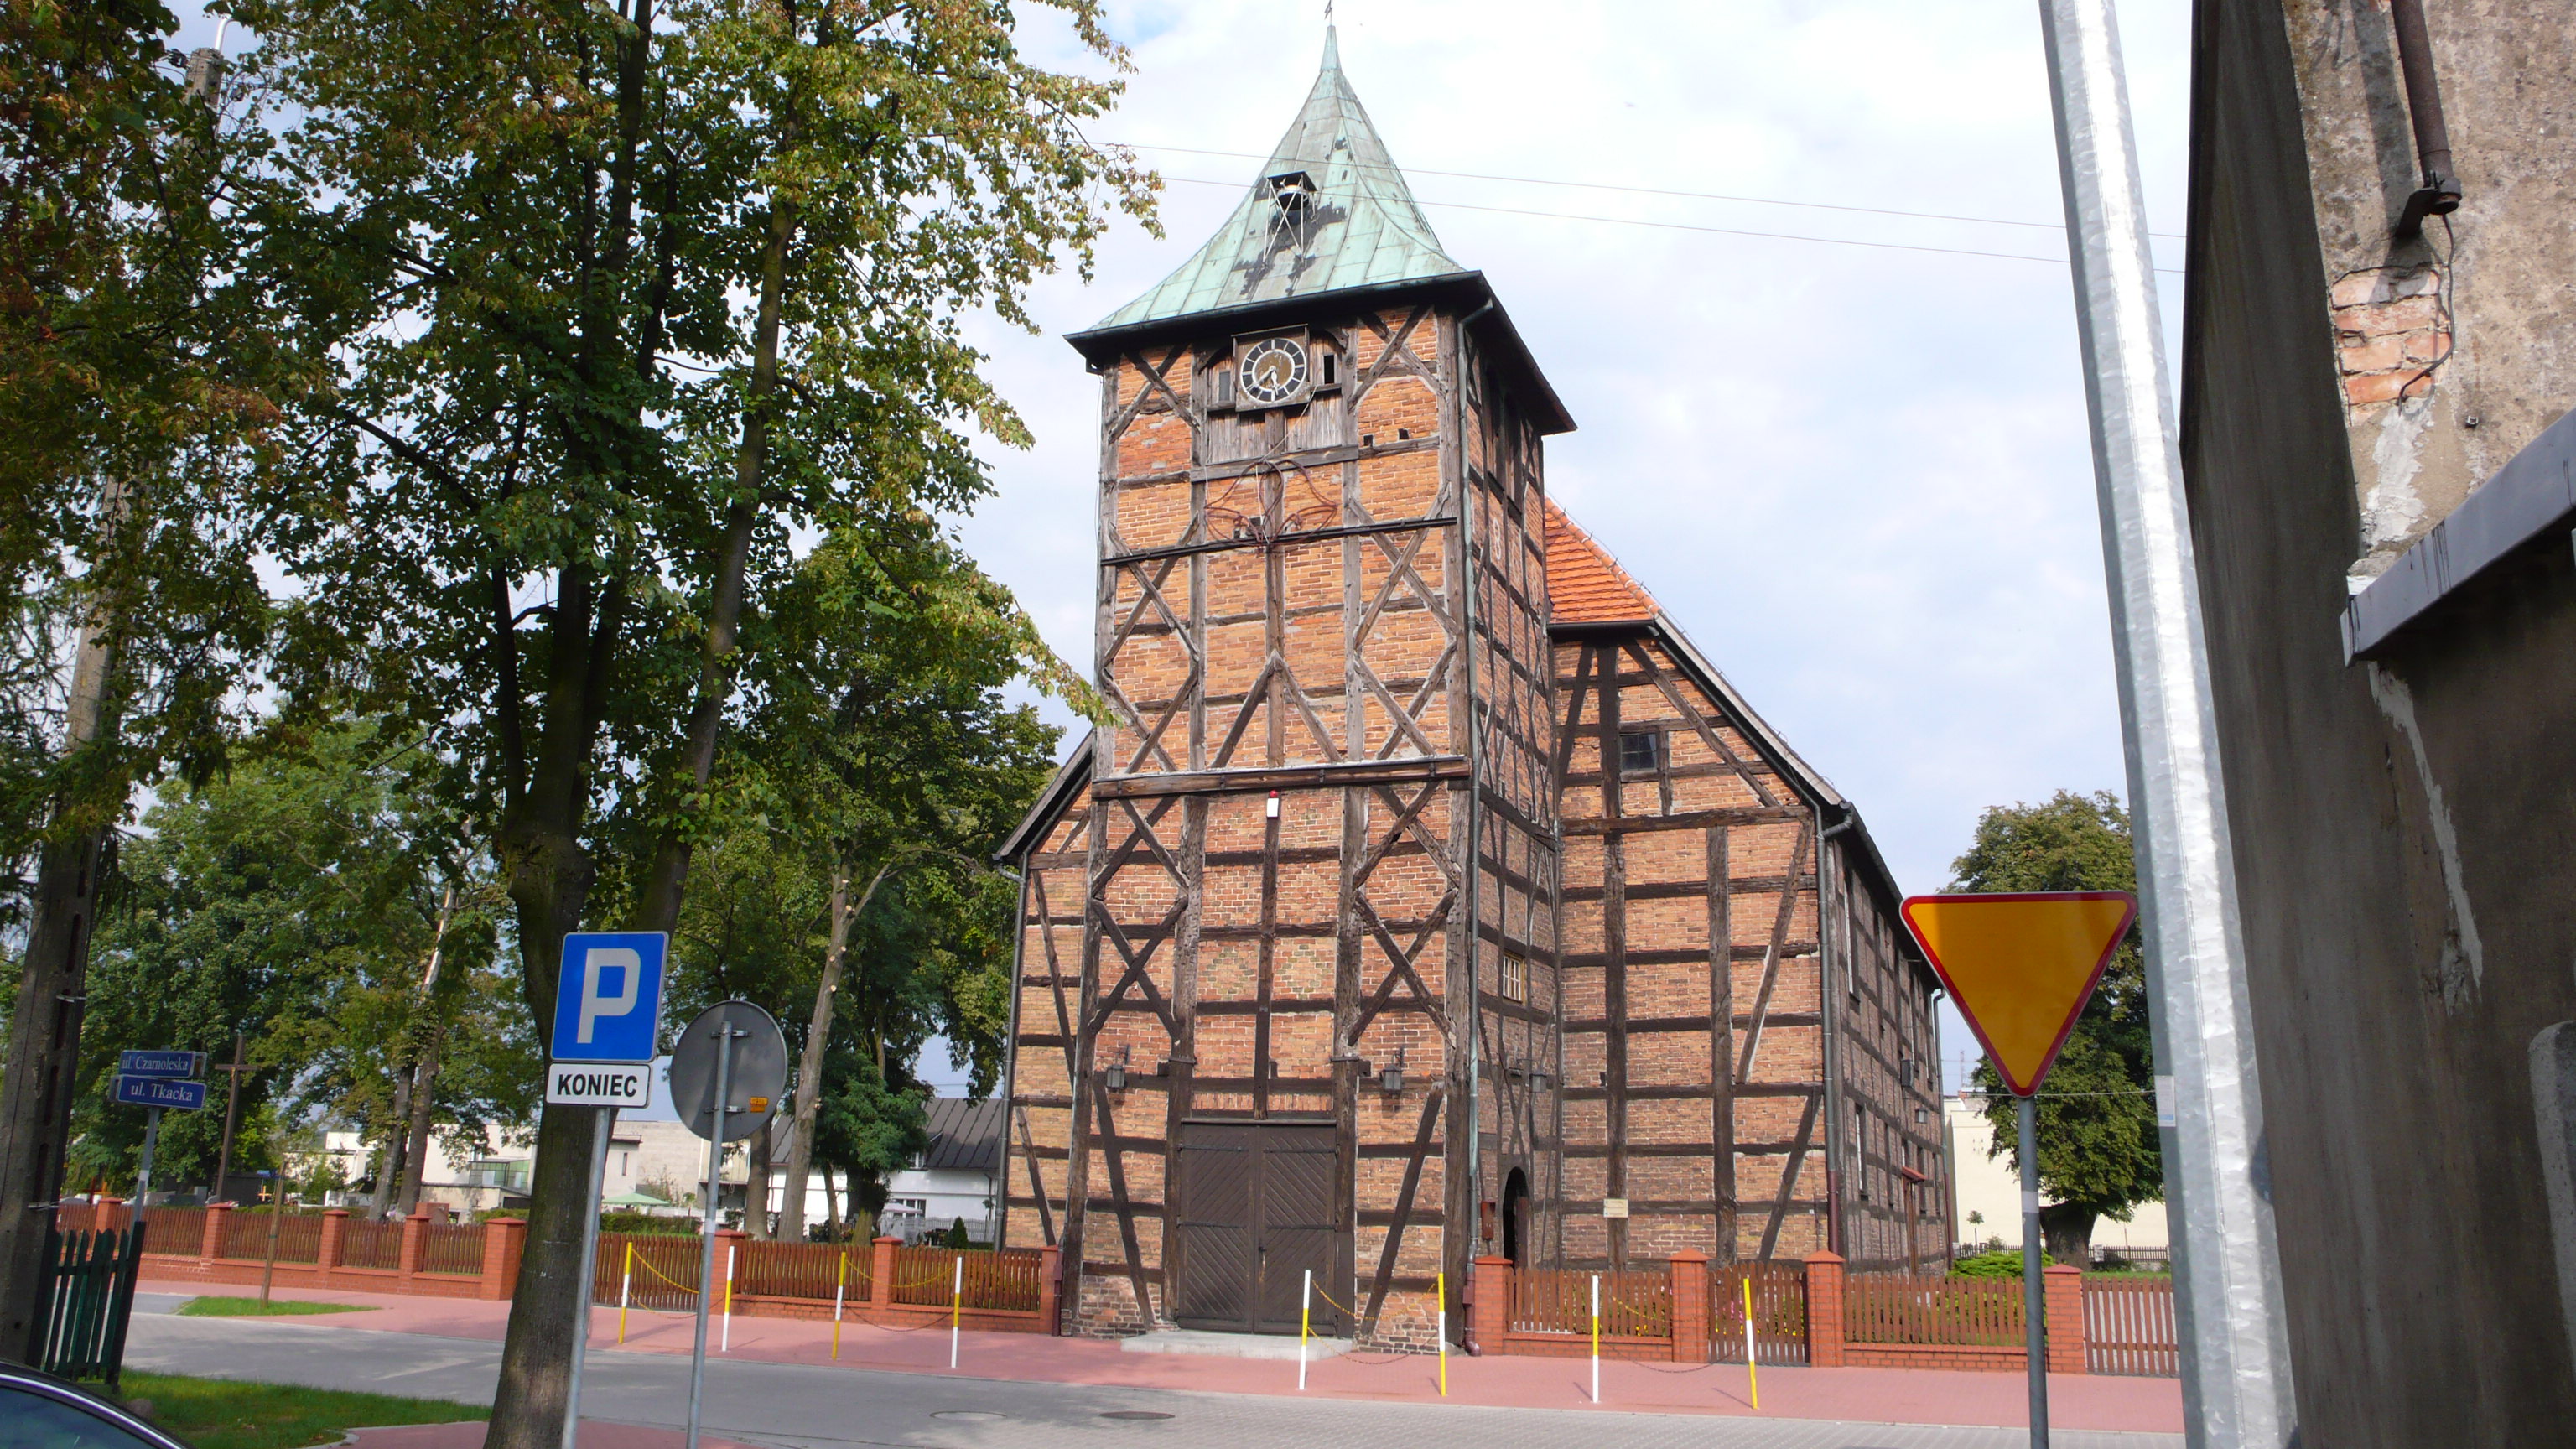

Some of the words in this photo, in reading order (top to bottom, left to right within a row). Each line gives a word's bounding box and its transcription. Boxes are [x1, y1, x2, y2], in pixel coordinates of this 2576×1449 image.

[577, 948, 641, 1044] P
[122, 1055, 132, 1069] ul.
[135, 1055, 189, 1071] Czarnoleska
[131, 1082, 145, 1096] ul.
[151, 1083, 193, 1101] Tkacka
[558, 1074, 637, 1097] KONIEC
